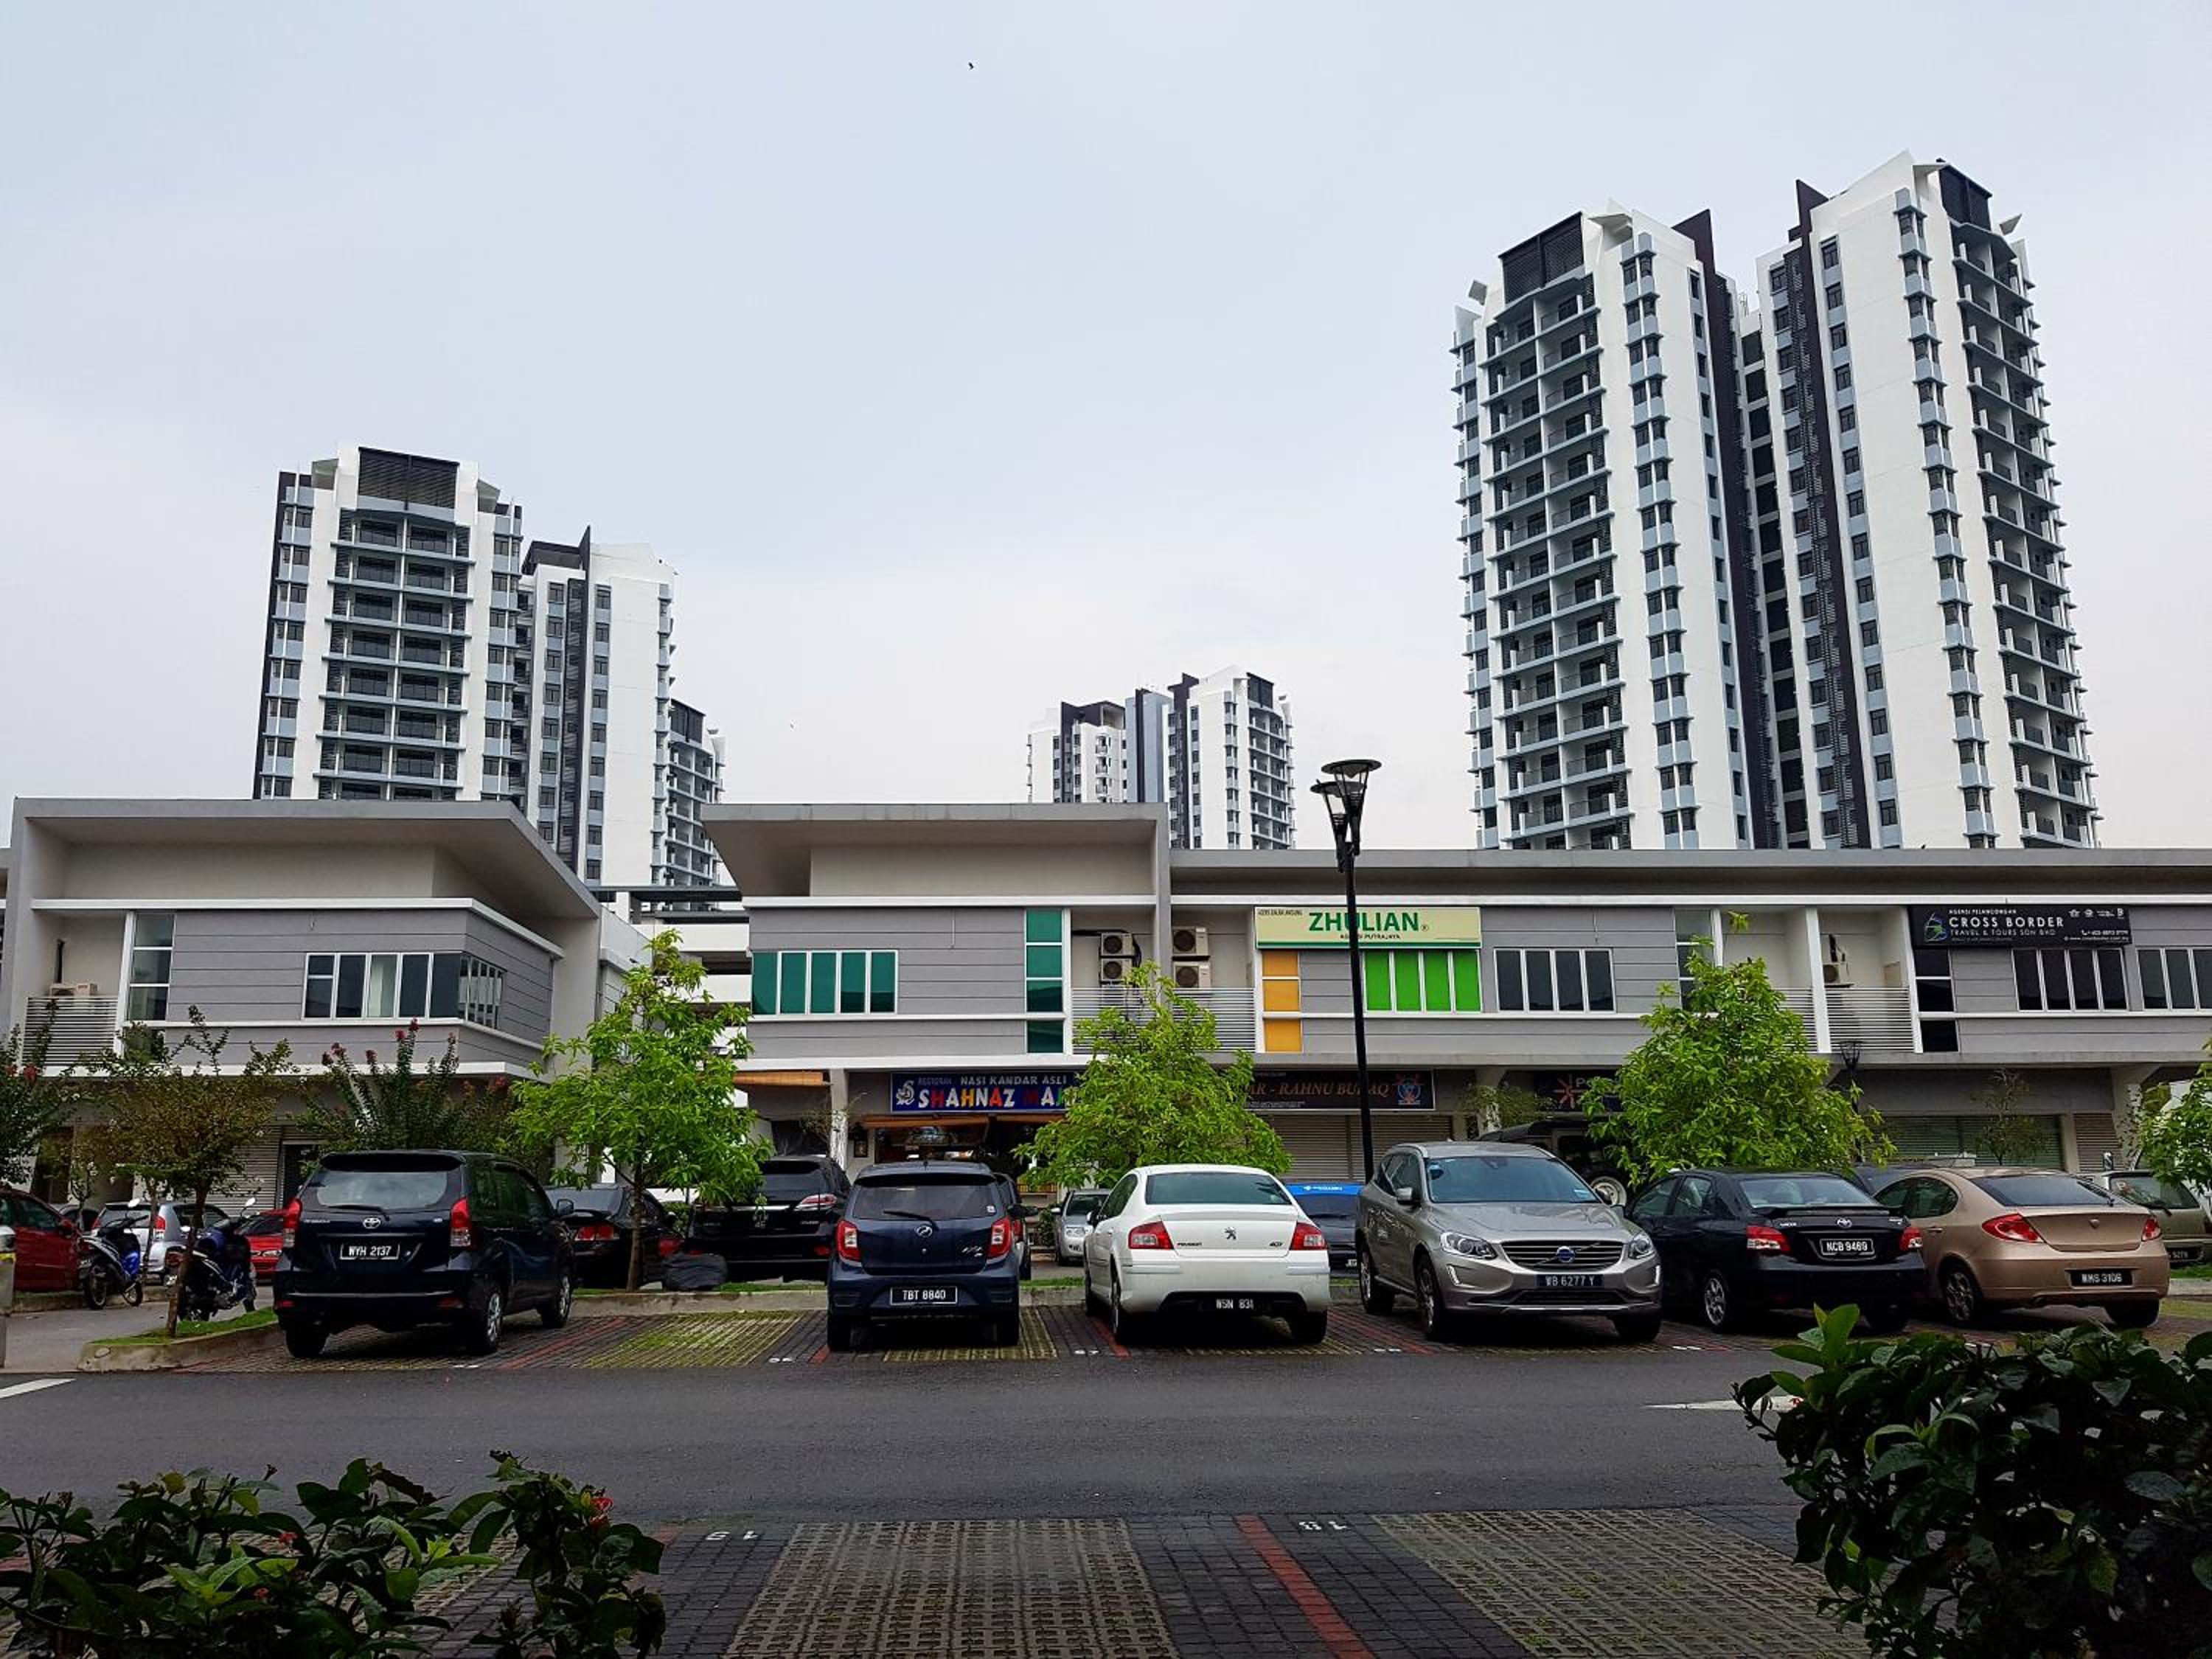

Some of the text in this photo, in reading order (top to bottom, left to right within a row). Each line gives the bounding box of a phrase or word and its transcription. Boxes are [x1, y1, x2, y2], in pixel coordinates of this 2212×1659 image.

[1949, 917, 2064, 928] CROSS BORDER
[960, 1075, 987, 1085] NASI
[990, 1075, 1038, 1085] KANDAR
[1042, 1074, 1068, 1085] ASLI
[1279, 1082, 1334, 1095] RAHNU
[1337, 1082, 1390, 1098] BUAQ
[918, 1087, 1015, 1108] SHAHNAZ
[349, 1245, 392, 1256] WYH 2137
[1826, 1241, 1843, 1251] NCB
[1545, 1276, 1595, 1287] WB 6277 Y
[902, 1290, 947, 1301] TBT 8840
